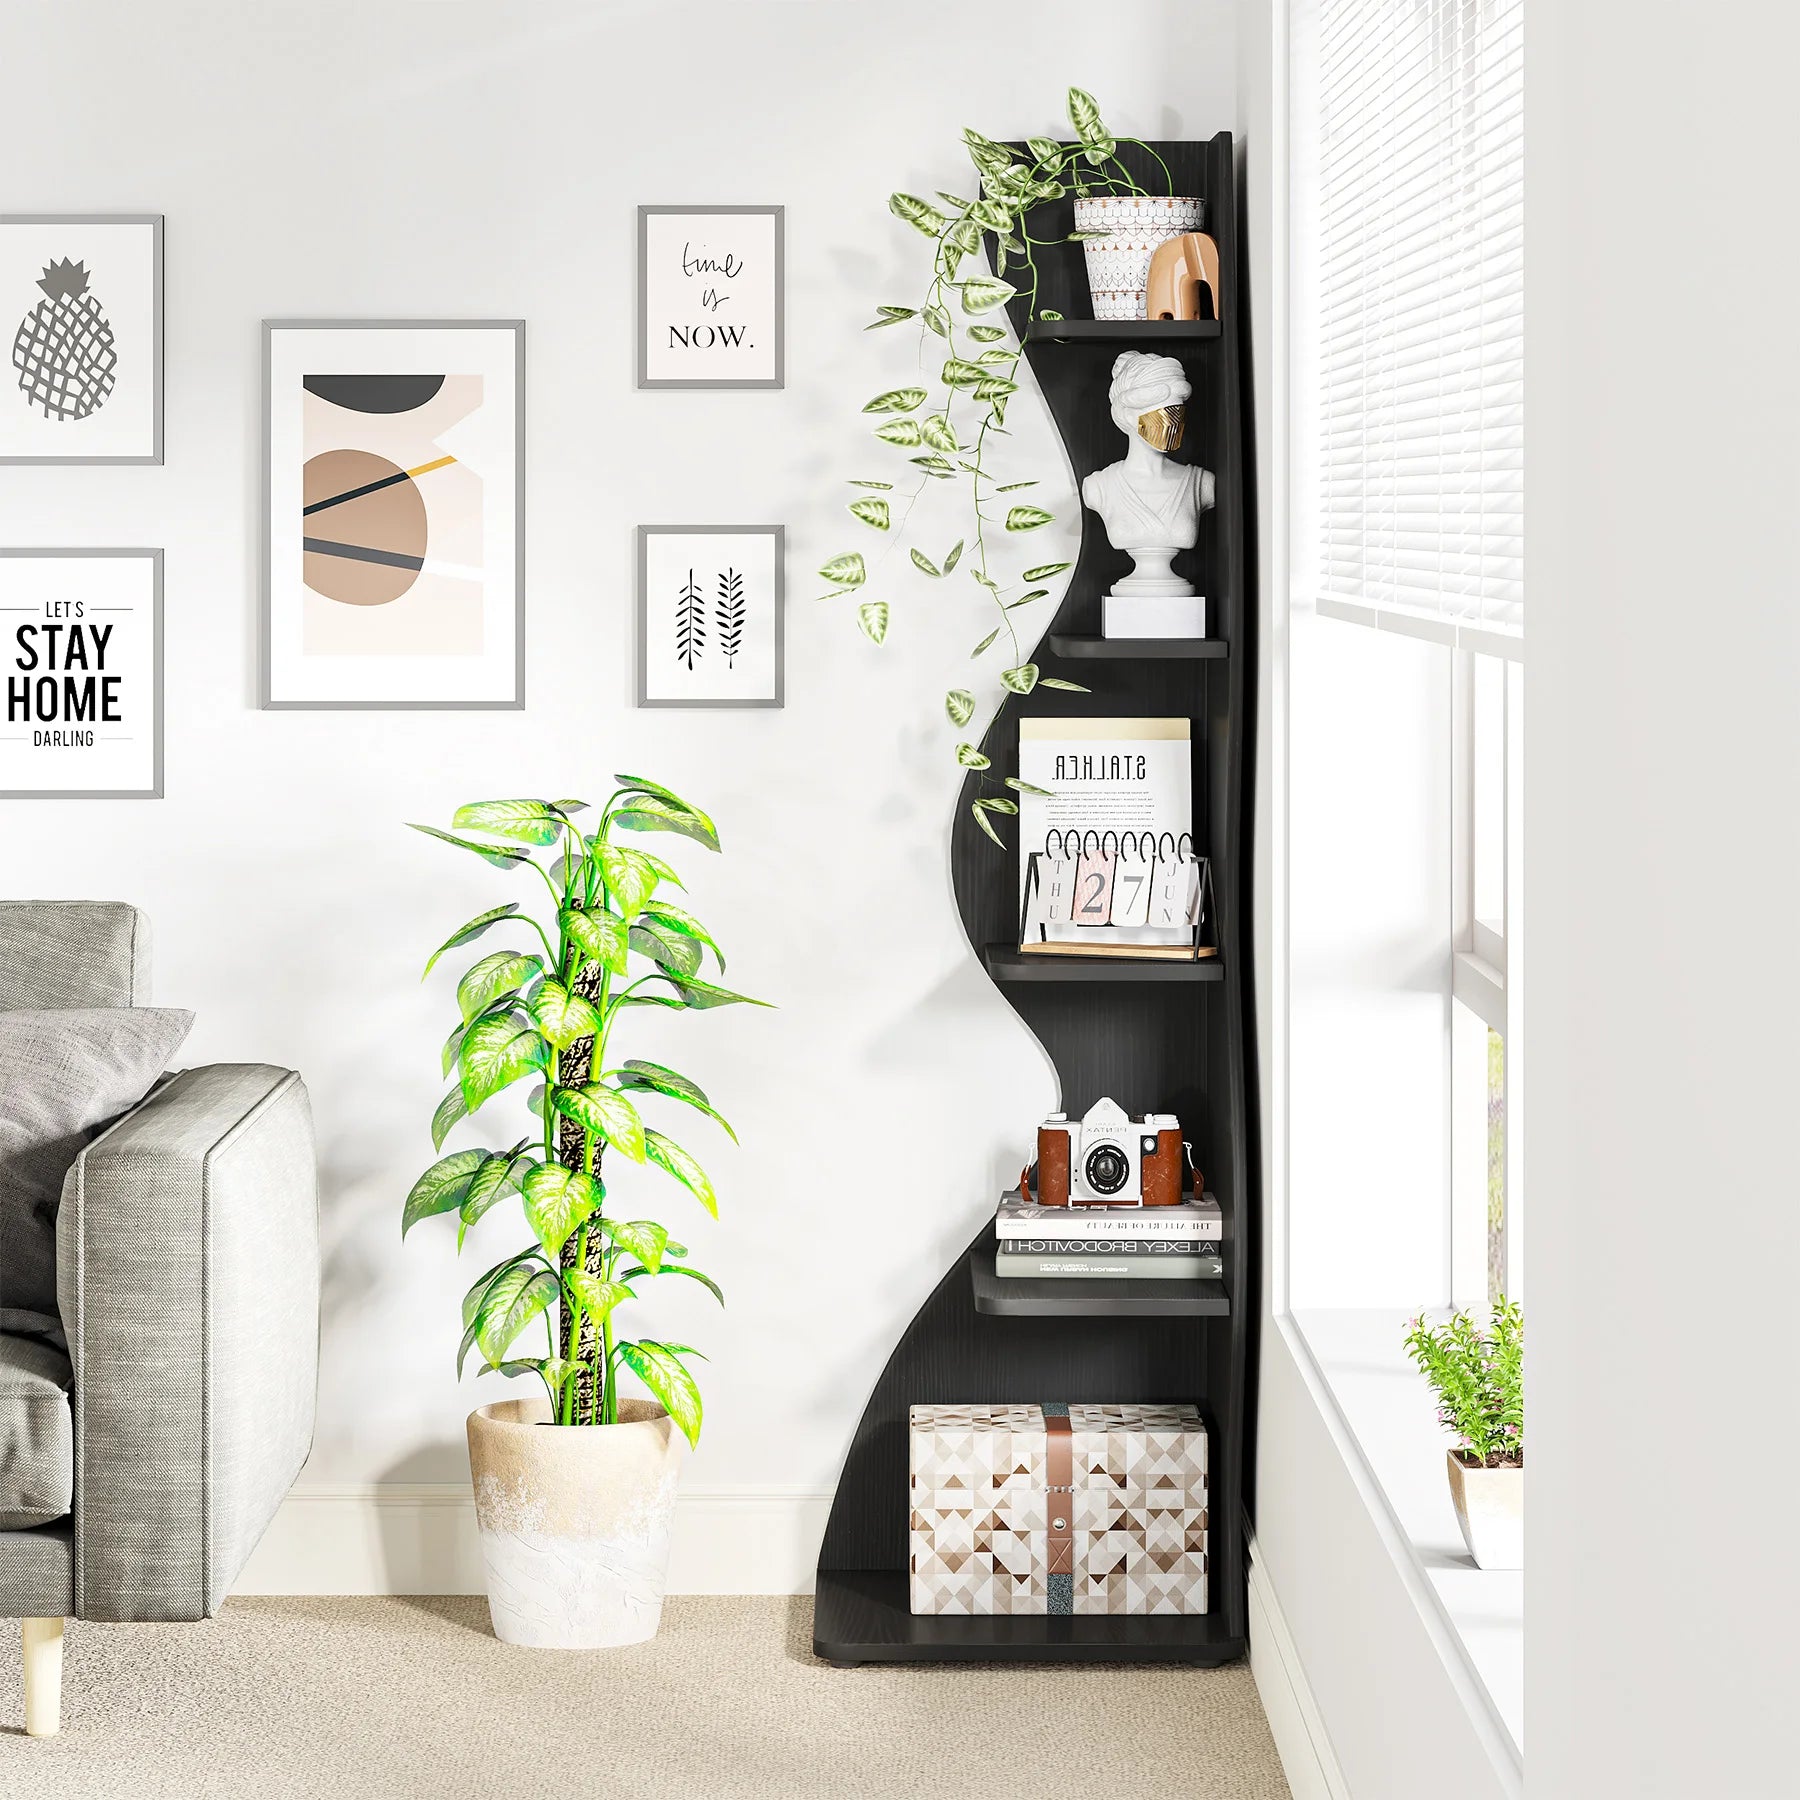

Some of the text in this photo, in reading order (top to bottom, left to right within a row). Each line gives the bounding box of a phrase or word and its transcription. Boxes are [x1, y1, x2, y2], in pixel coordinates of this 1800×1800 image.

[682, 241, 743, 278] time
[702, 282, 730, 312] is
[668, 325, 754, 348] NOW.
[16, 624, 114, 671] STAY
[8, 676, 122, 722] HOME
[34, 730, 94, 747] DARLING
